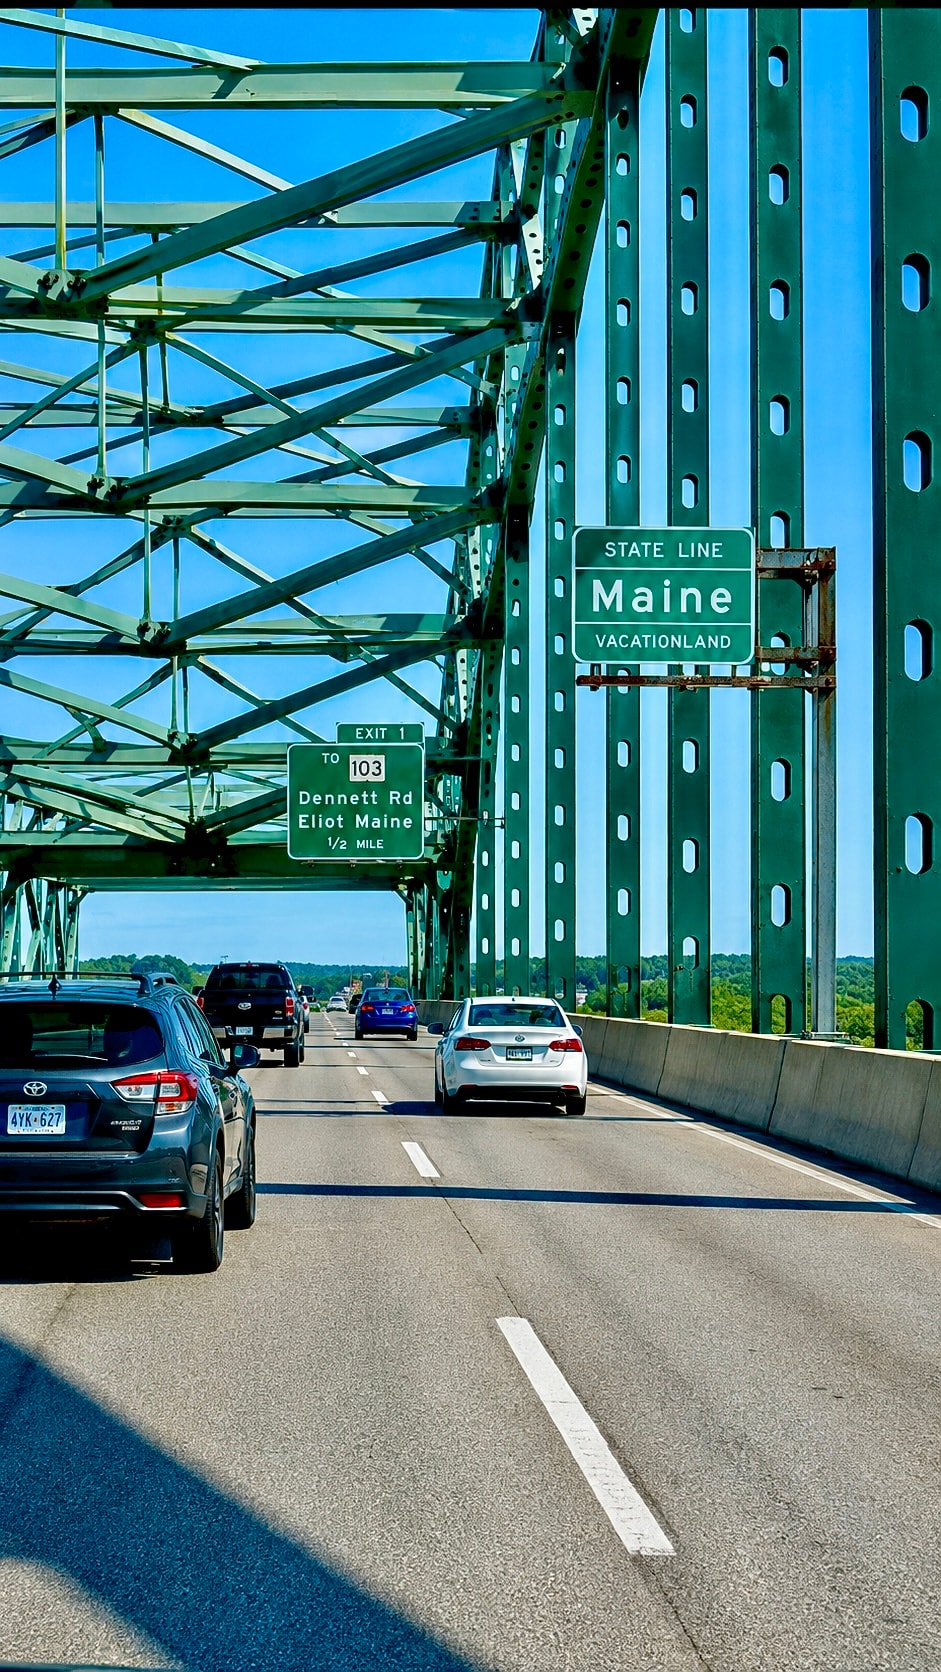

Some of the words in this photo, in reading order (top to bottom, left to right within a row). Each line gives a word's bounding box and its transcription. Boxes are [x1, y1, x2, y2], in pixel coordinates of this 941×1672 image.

[604, 542, 665, 558] STATE
[678, 542, 723, 558] LINE
[592, 579, 732, 614] Maine
[595, 634, 731, 649] VACATIONLAND
[355, 728, 388, 740] EXIT
[399, 727, 405, 740] 1
[321, 753, 340, 764] TO
[351, 760, 382, 777] 103
[299, 790, 378, 805] Dennett
[389, 790, 413, 805] Rd
[298, 814, 344, 829] Eliot
[355, 814, 413, 829] Maine
[327, 837, 347, 850] 1/2
[356, 839, 384, 849] MILE
